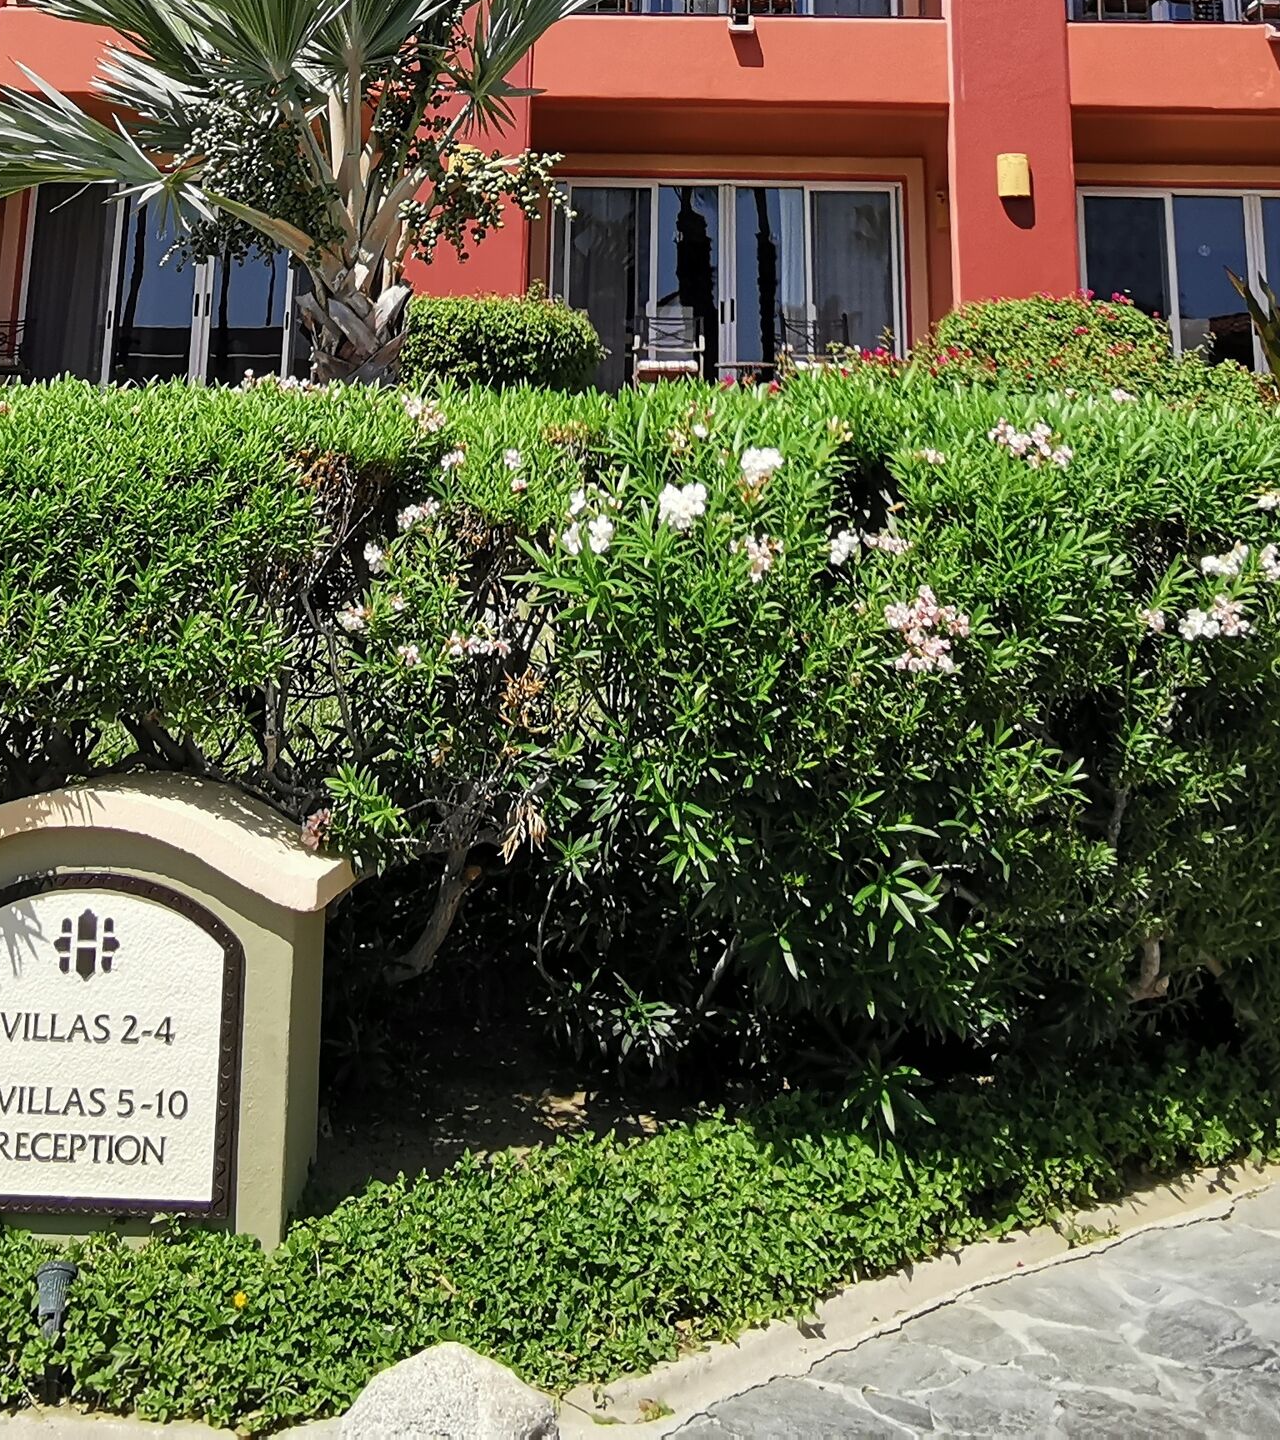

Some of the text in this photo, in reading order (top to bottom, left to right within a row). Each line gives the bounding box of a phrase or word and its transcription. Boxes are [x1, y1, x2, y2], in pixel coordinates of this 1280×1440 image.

[0, 1012, 175, 1045] VILLAS 2-4
[117, 1088, 188, 1120] 5-10
